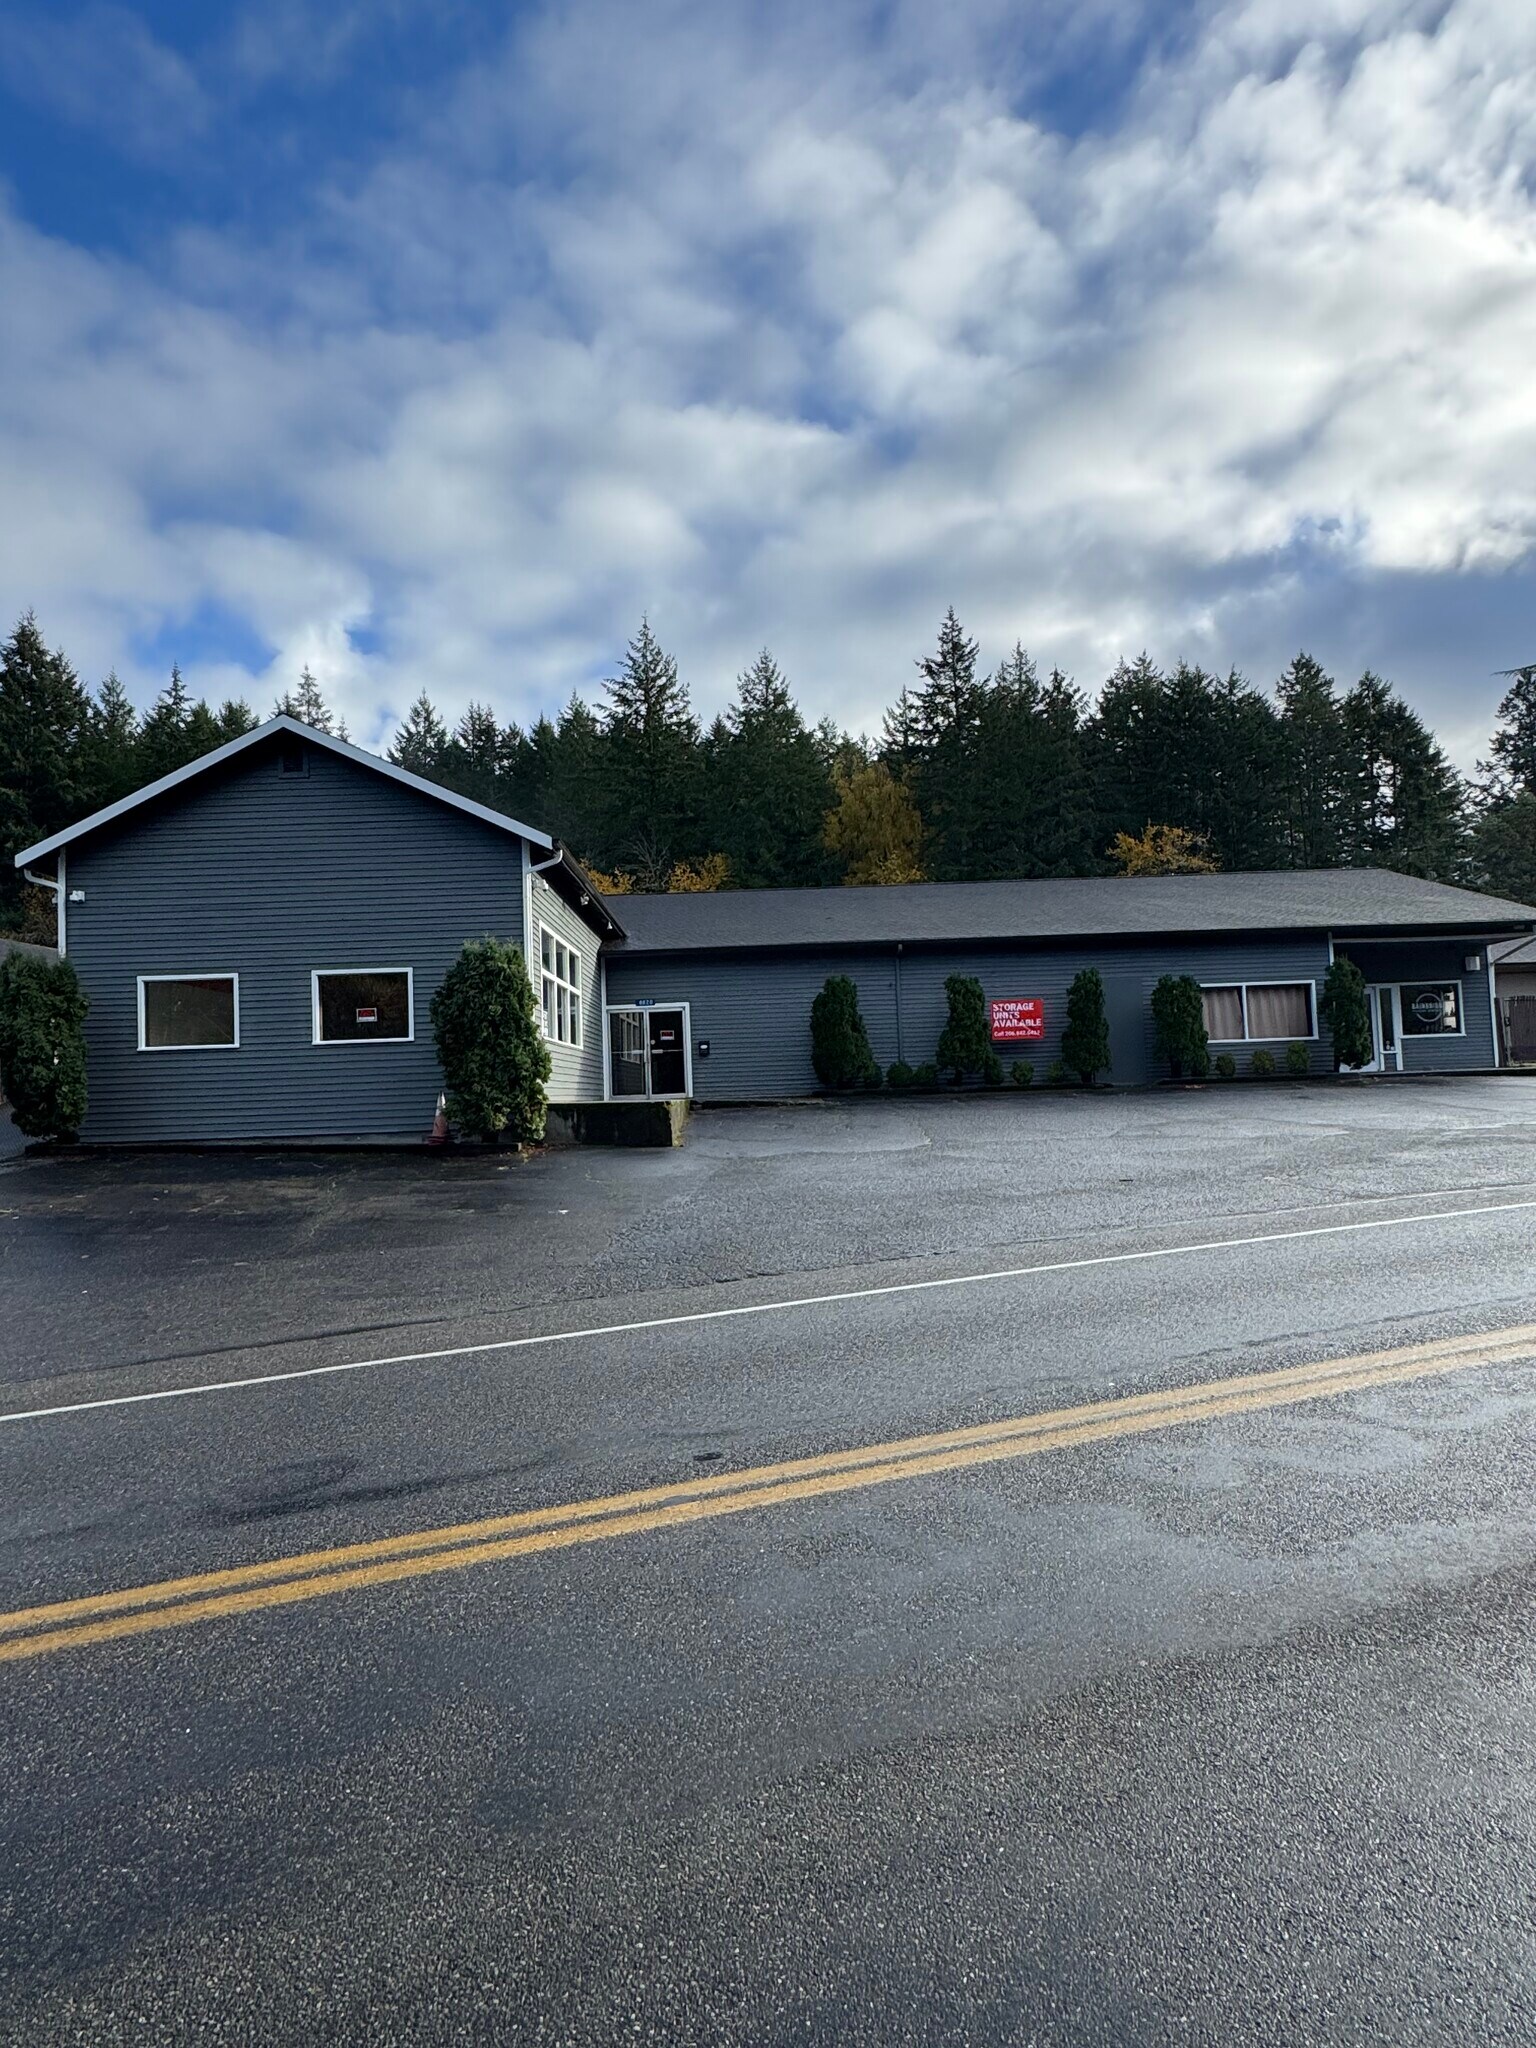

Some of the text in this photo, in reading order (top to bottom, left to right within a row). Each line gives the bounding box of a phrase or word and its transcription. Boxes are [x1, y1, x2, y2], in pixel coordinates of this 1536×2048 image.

[993, 1002, 1034, 1011] STORAGE
[993, 1011, 1020, 1020] UNITS
[993, 1018, 1041, 1027] AVAILABLE
